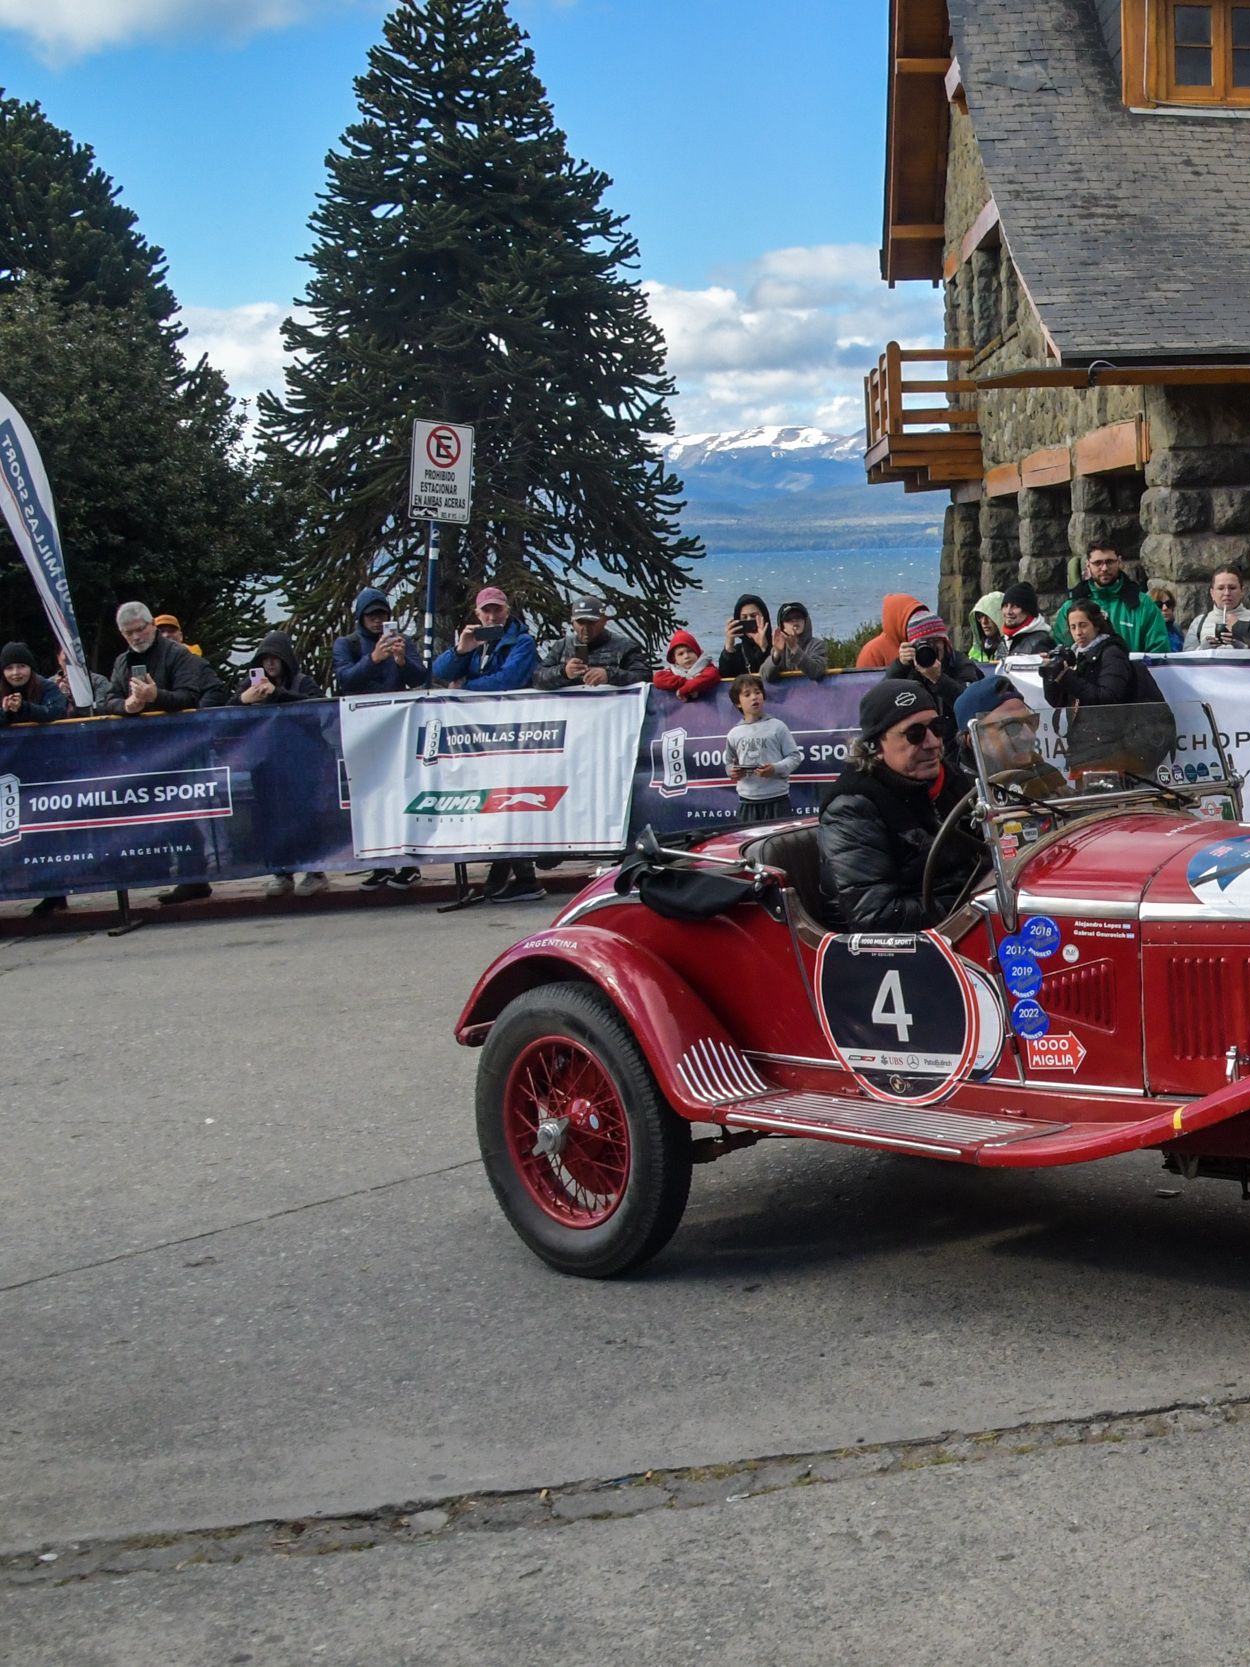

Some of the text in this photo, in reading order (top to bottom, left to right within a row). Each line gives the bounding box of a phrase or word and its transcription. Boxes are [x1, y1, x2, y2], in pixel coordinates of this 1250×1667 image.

[425, 469, 455, 481] PROHIBIDO
[420, 482, 457, 495] ESTACIONAR
[414, 494, 466, 509] EN AMBAS ACERAS
[427, 723, 439, 758] 1000
[446, 729, 559, 746] 1000 MILLAS SPORT
[740, 736, 768, 749] SHARK
[670, 737, 683, 784] 1000
[29, 781, 218, 812] 1000 MILLAS SPORT
[4, 783, 16, 830] 1000
[416, 795, 481, 811] PUMA
[24, 852, 94, 865] PATAGONIA
[121, 844, 192, 857] ARGENTINA
[1030, 925, 1052, 936] 2018
[1074, 920, 1122, 930] Alejandro Lopez
[1073, 929, 1095, 937] Gabriel
[523, 938, 578, 949] ARGENTINA
[1028, 947, 1052, 957] PASSED
[1011, 966, 1033, 976] 2019
[1012, 989, 1035, 998] PASSED
[871, 969, 913, 1042] 4
[1019, 1008, 1039, 1018] 2022
[1020, 1031, 1043, 1040] PASSED
[1032, 1039, 1069, 1050] 1000
[888, 1056, 904, 1066] UBS
[1032, 1054, 1074, 1066] MIGLIA
